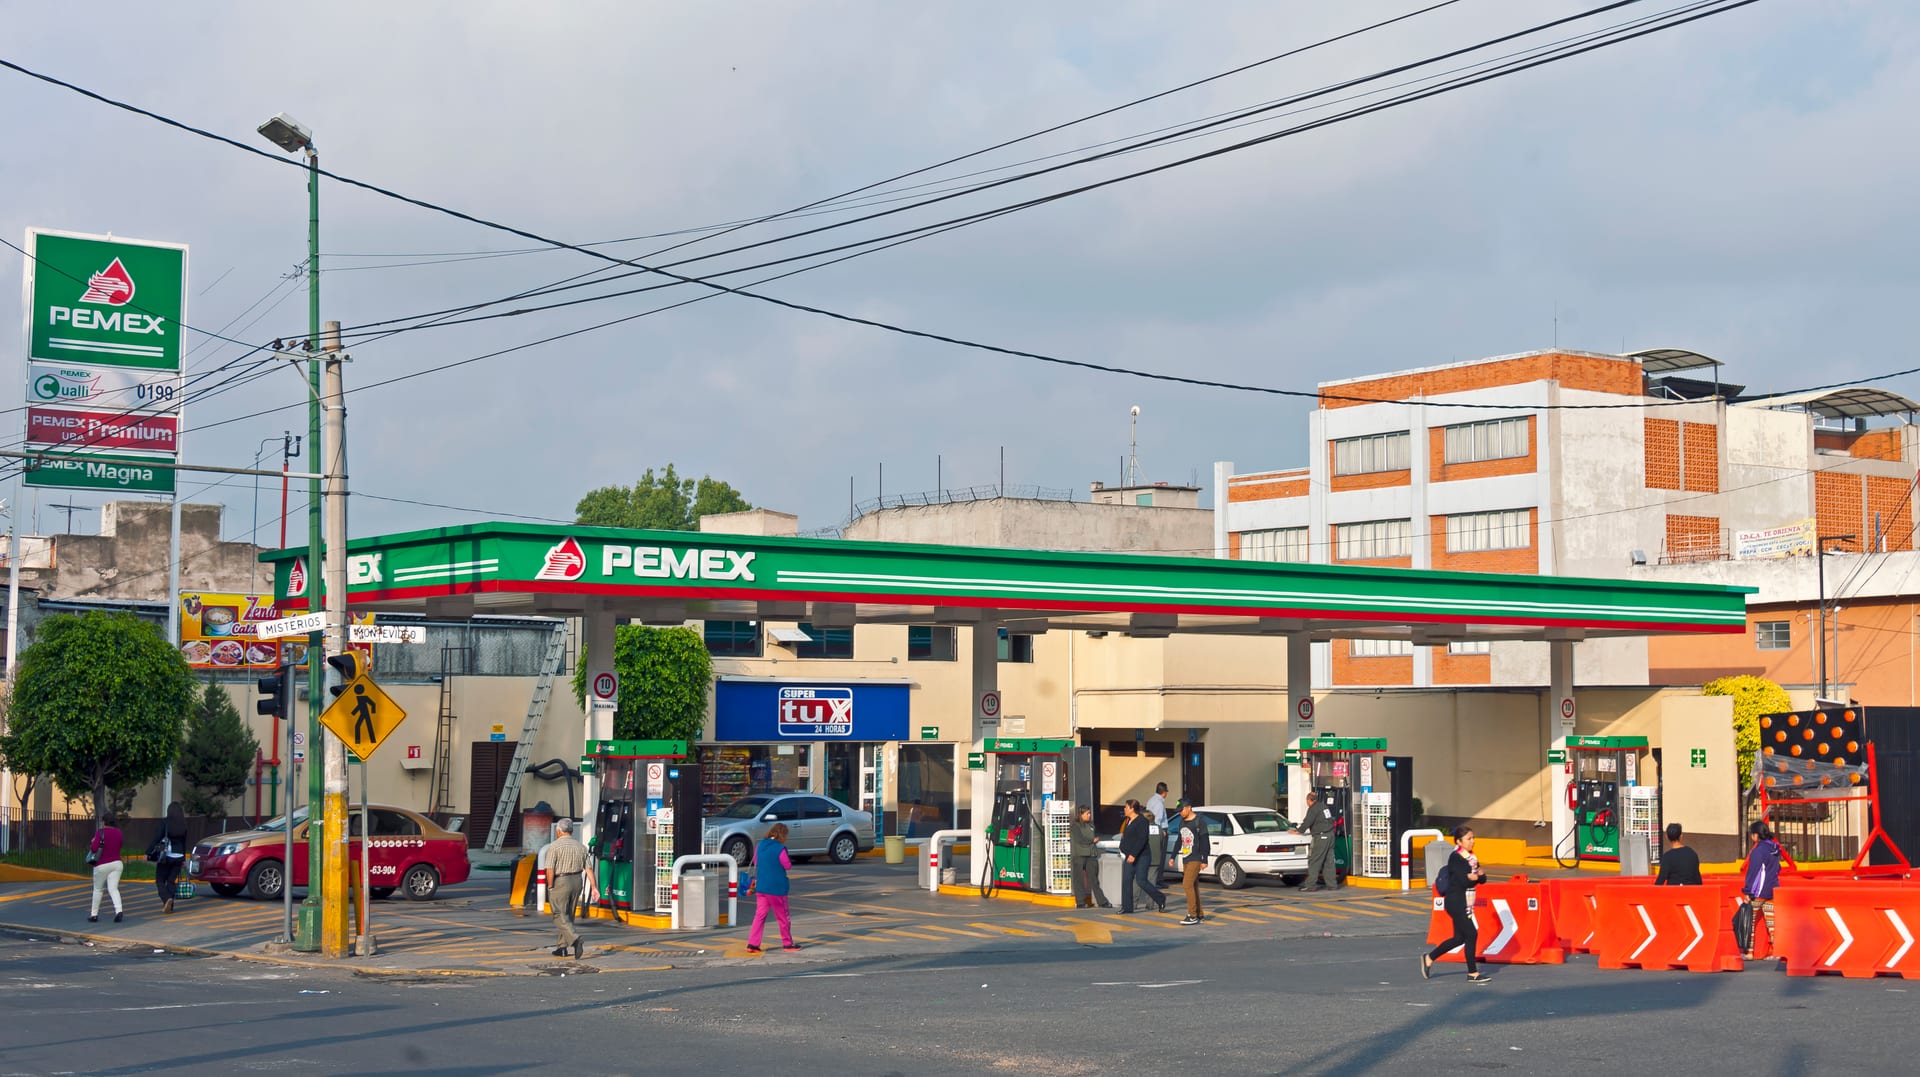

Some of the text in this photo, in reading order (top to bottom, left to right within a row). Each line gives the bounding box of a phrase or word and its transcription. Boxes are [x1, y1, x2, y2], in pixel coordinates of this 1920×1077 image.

[50, 305, 165, 335] PEMEX
[60, 369, 91, 378] PEMEX
[137, 383, 173, 401] 0199
[32, 414, 173, 442] PEMEX Premium
[86, 461, 153, 485] Magna
[602, 544, 756, 582] PEMEX
[265, 616, 321, 635] MISTERIOS
[600, 678, 611, 690] 10
[783, 689, 816, 699] SUPER
[814, 725, 846, 734] 24 HORAS
[1032, 742, 1038, 751] 3
[1353, 740, 1358, 749] 5
[1376, 740, 1382, 749] 6
[369, 865, 397, 875] -63-904
